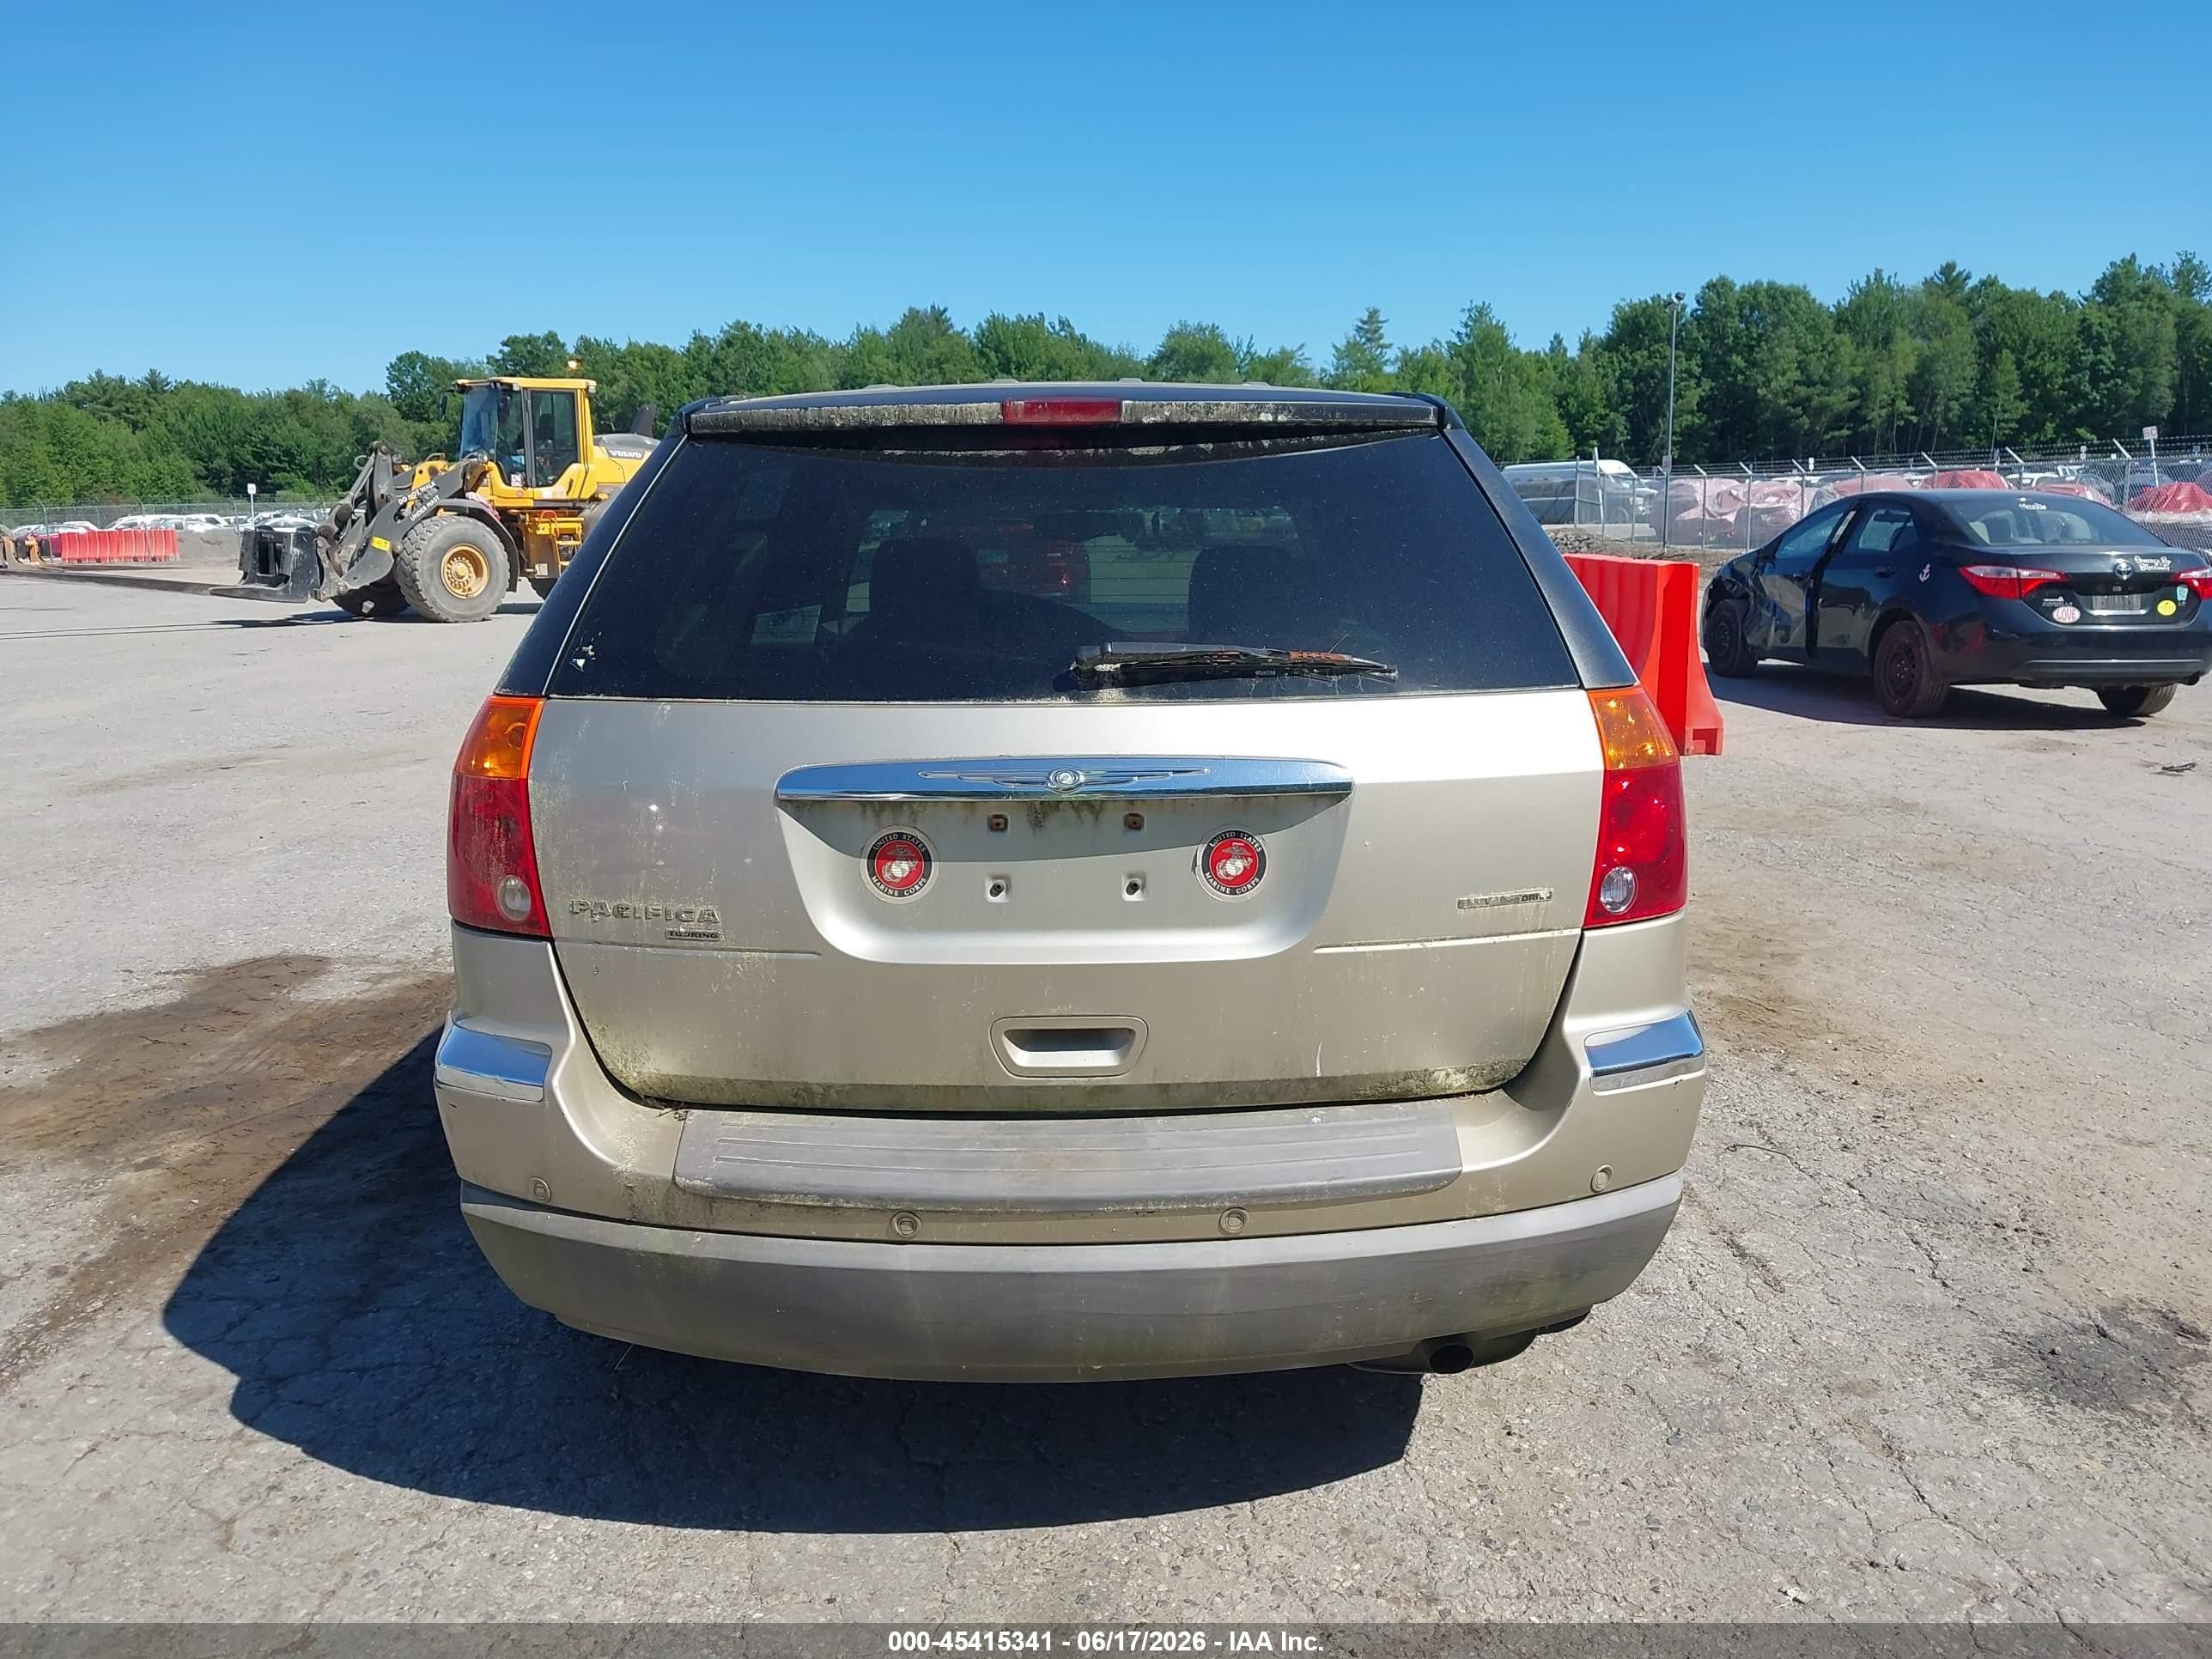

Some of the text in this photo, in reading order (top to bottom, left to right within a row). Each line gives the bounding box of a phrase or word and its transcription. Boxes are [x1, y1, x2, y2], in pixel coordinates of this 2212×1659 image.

[609, 450, 642, 459] VOLVO
[398, 496, 408, 505] DO
[420, 480, 437, 493] WALK
[410, 495, 441, 522] UNDER MAST
[873, 833, 927, 854] UNITED STATES
[1209, 831, 1262, 853] UNITED STATES
[871, 875, 927, 896] MARINE CORPS
[1205, 872, 1261, 894] MARINE CORPS
[568, 898, 721, 924] PACIFICA
[667, 930, 719, 939] TOURING
